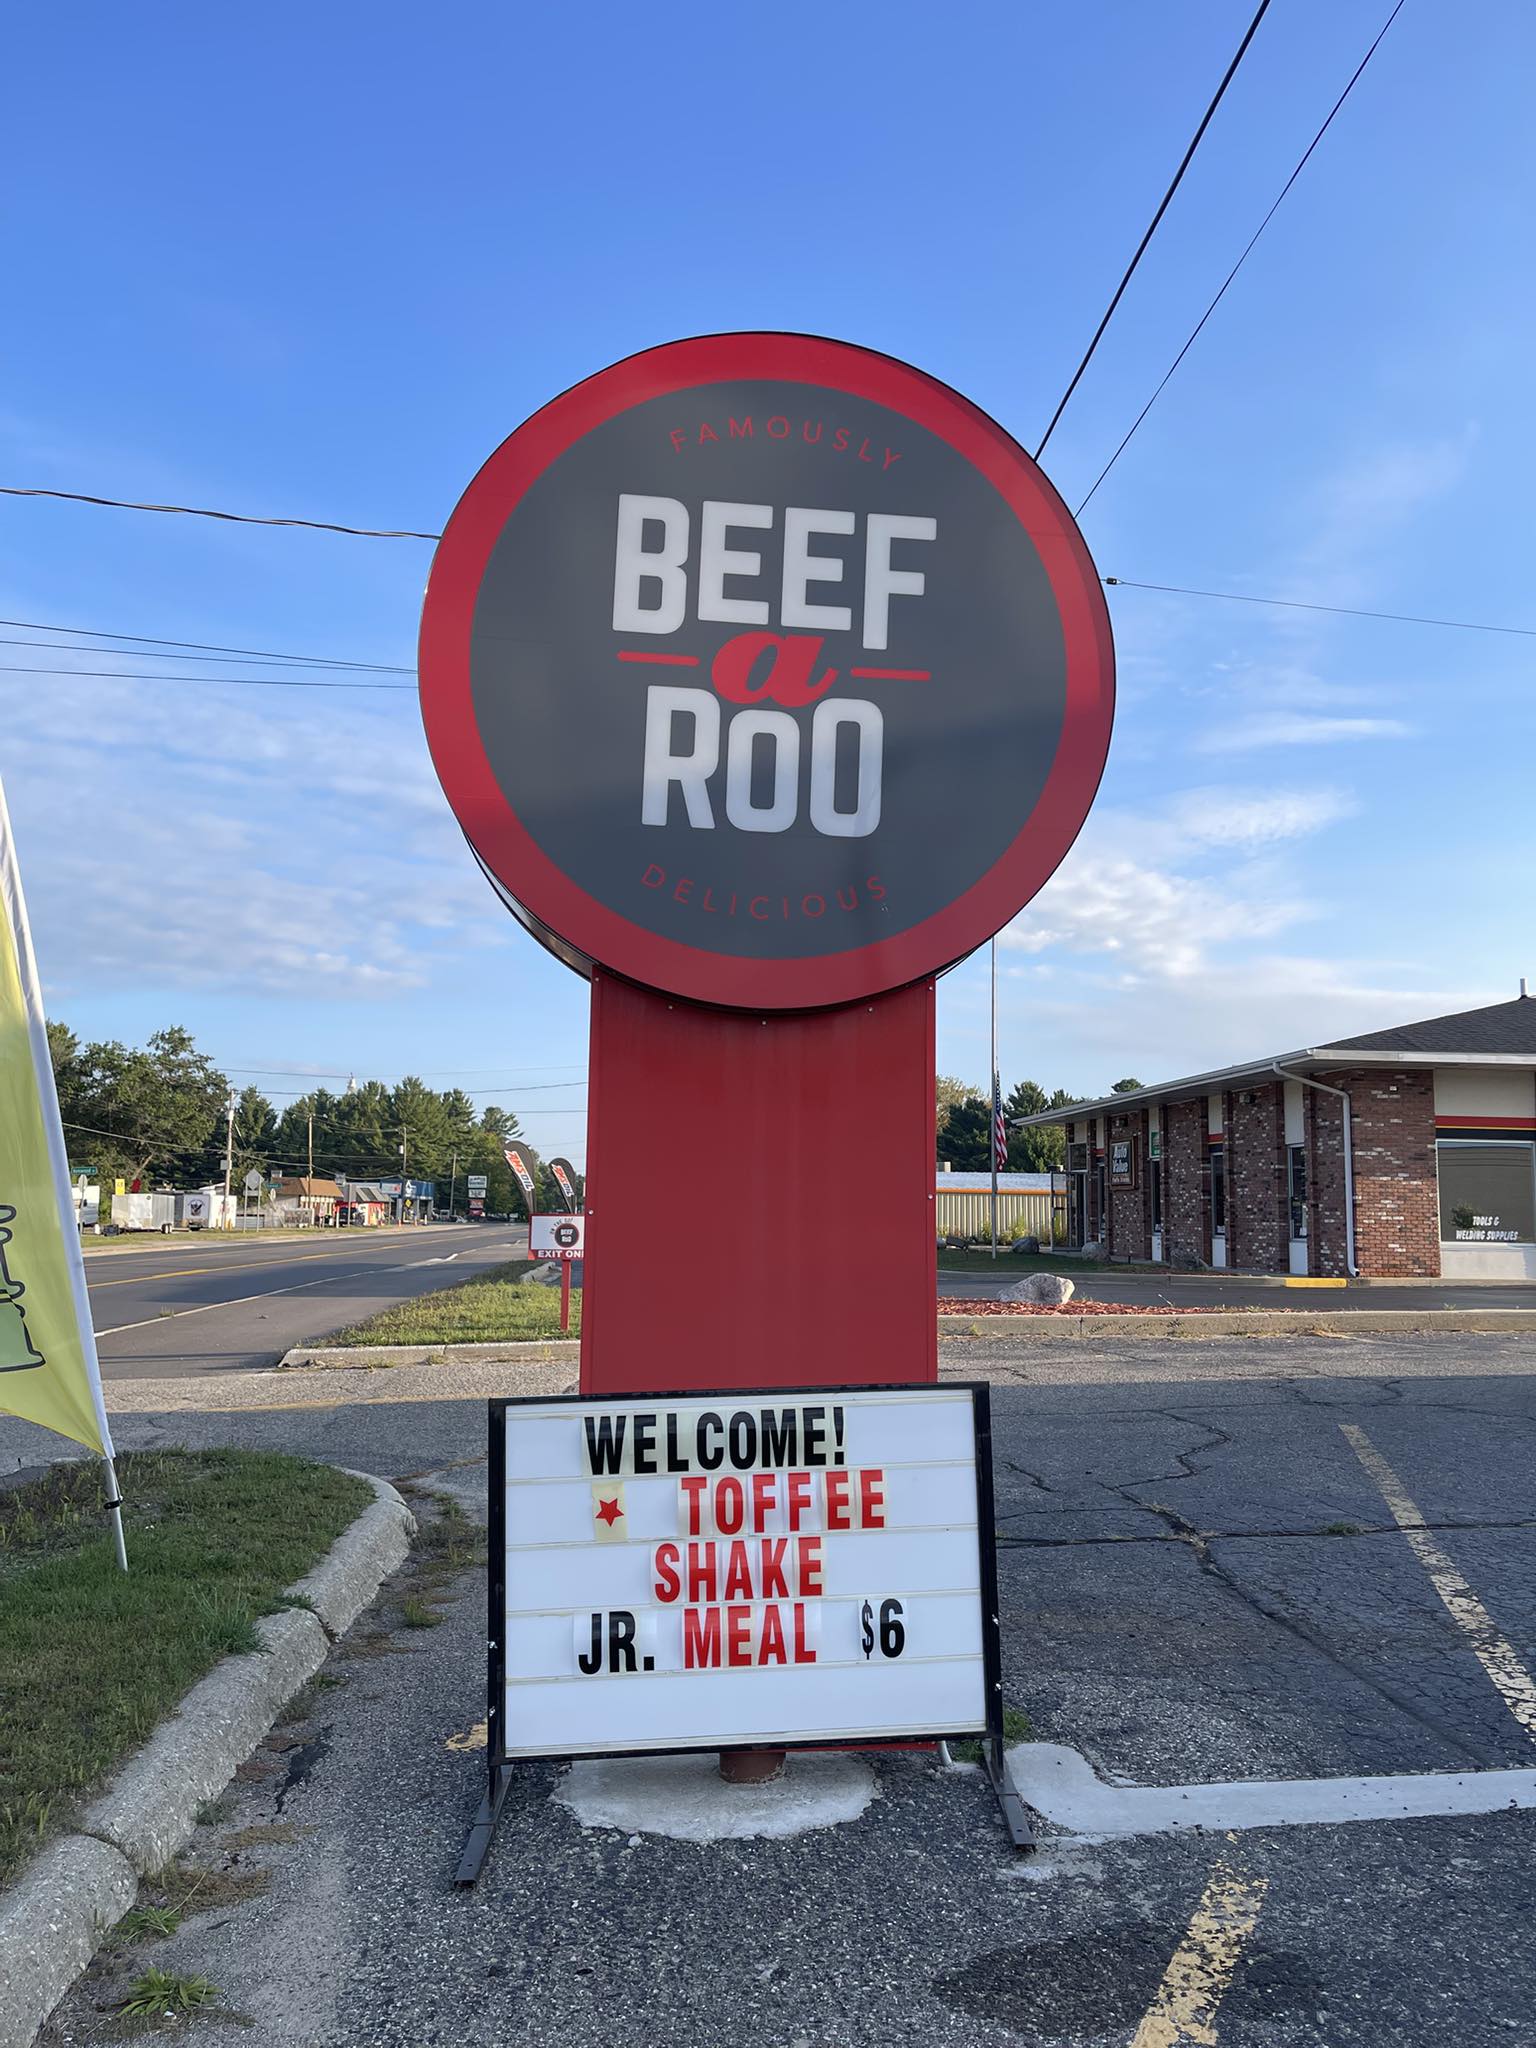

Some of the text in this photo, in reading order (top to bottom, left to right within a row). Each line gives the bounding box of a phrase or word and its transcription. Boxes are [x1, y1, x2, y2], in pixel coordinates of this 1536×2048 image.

[669, 415, 903, 472] FAMOUSLY
[612, 493, 937, 650] BEEF
[711, 631, 839, 708] a
[641, 685, 884, 838] ROO
[640, 863, 888, 920] DELICIOUS
[504, 1150, 535, 1192] AMSOIL
[1112, 1160, 1128, 1173] Value
[1113, 1145, 1127, 1159] Auto
[1456, 1230, 1519, 1241] WELDING SUPPLIES
[1472, 1216, 1493, 1226] TOOLS
[537, 1250, 563, 1258] EXIT
[585, 1406, 846, 1475] WELCOME!
[681, 1469, 885, 1535] TOFFEE
[655, 1536, 823, 1603] SHAKE
[578, 1598, 905, 1675] JR. MEAL $6
